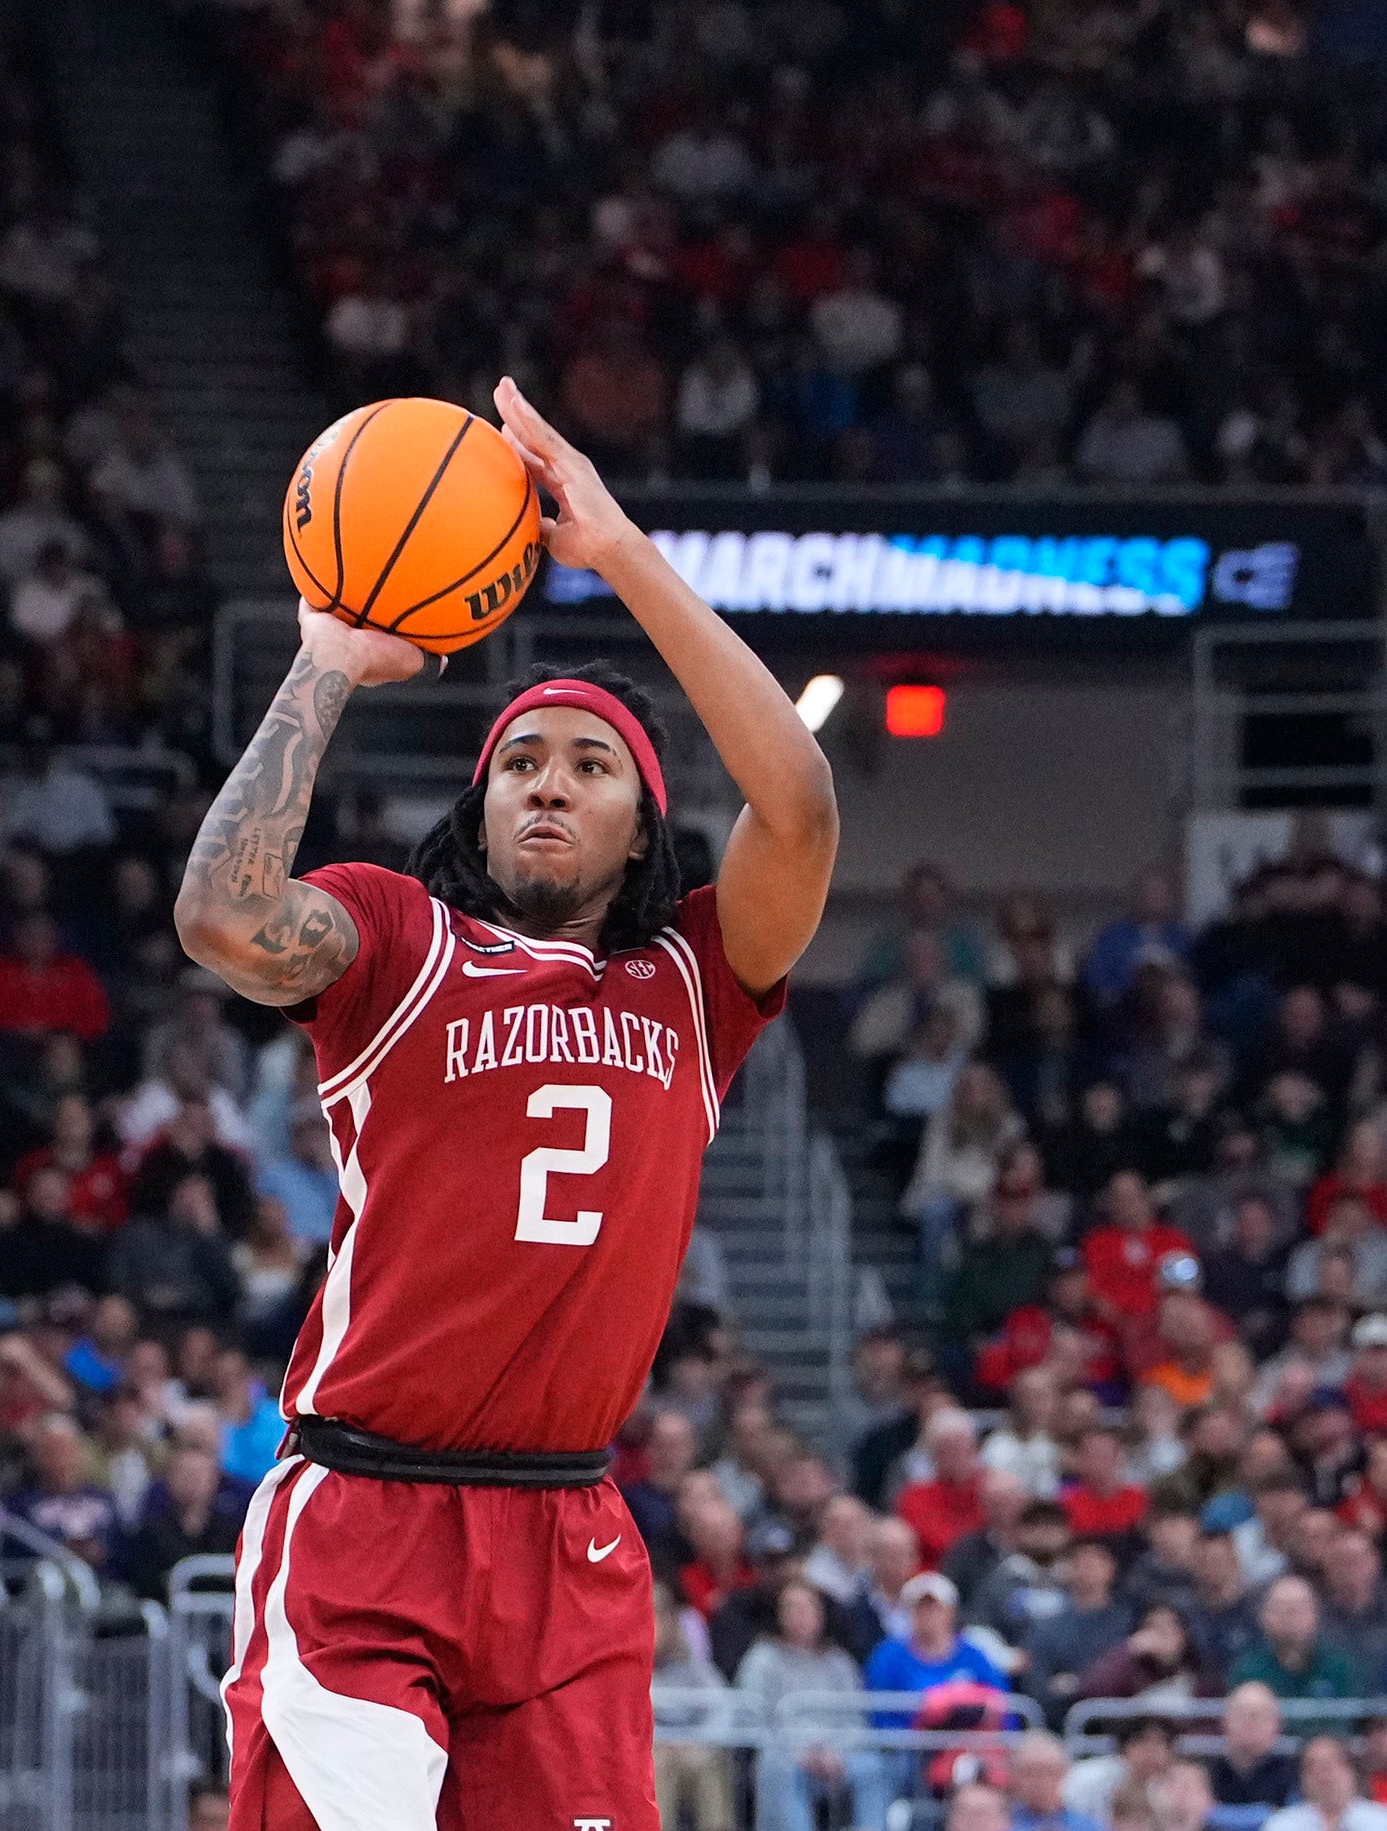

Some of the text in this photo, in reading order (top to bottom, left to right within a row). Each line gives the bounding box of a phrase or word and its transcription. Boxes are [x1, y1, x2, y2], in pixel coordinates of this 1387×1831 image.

[464, 542, 541, 620] Wil
[626, 960, 656, 979] SEC
[444, 1004, 679, 1090] RAZORBACKS
[514, 1084, 612, 1246] 2
